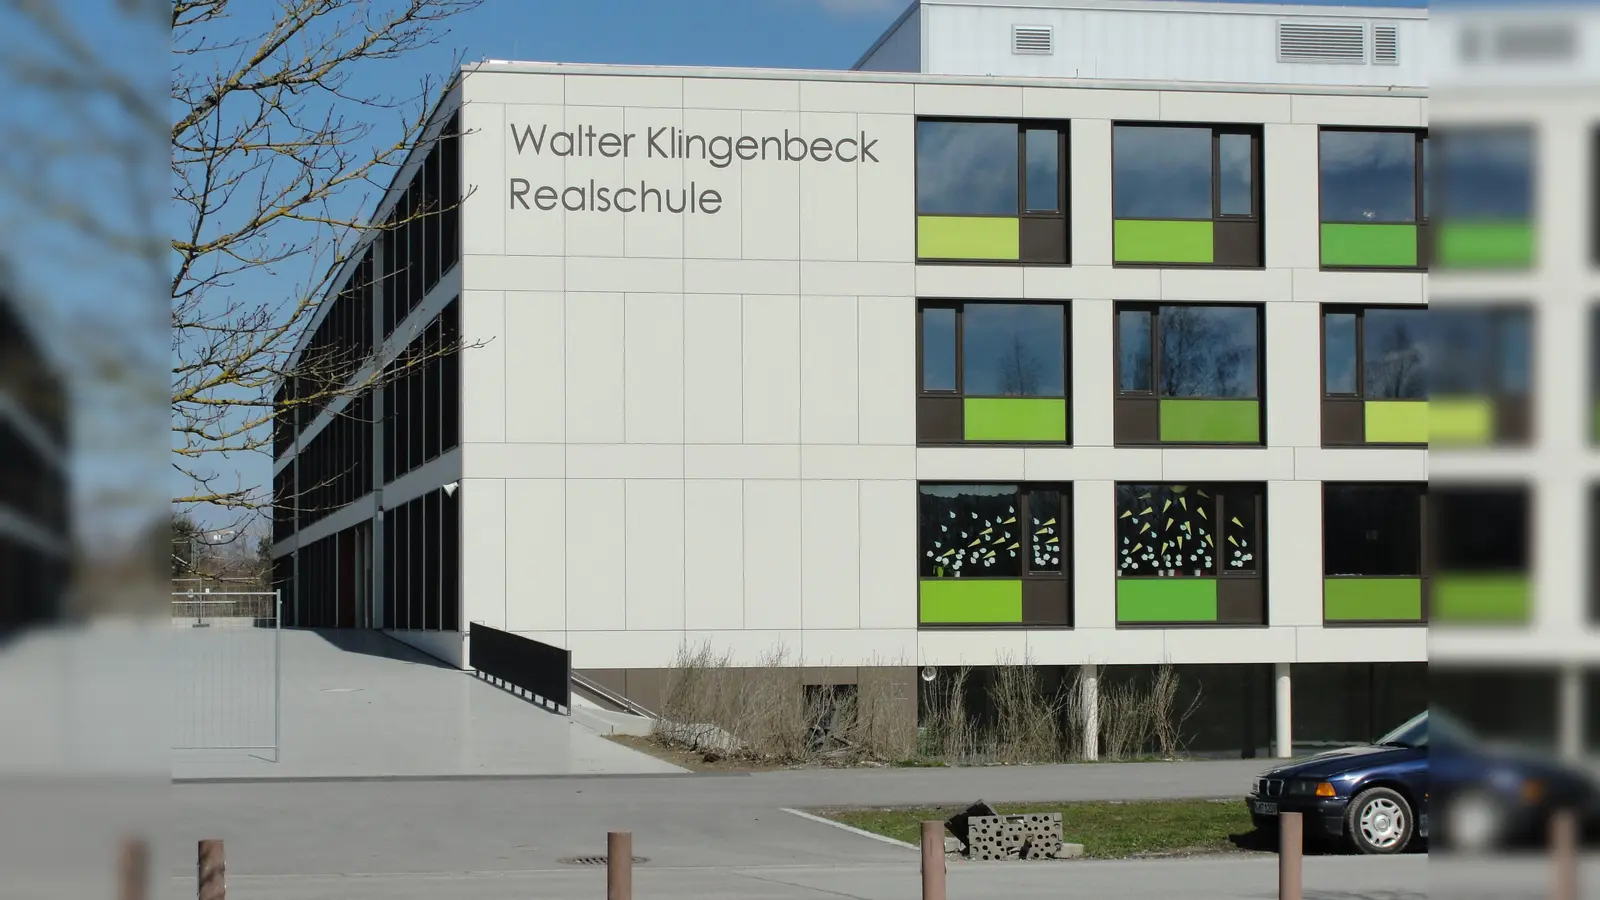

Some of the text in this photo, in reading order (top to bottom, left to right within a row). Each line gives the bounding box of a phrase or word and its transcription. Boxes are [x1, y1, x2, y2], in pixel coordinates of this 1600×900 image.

[510, 123, 880, 169] Walter Klingenbeck
[510, 177, 723, 215] Realschule
